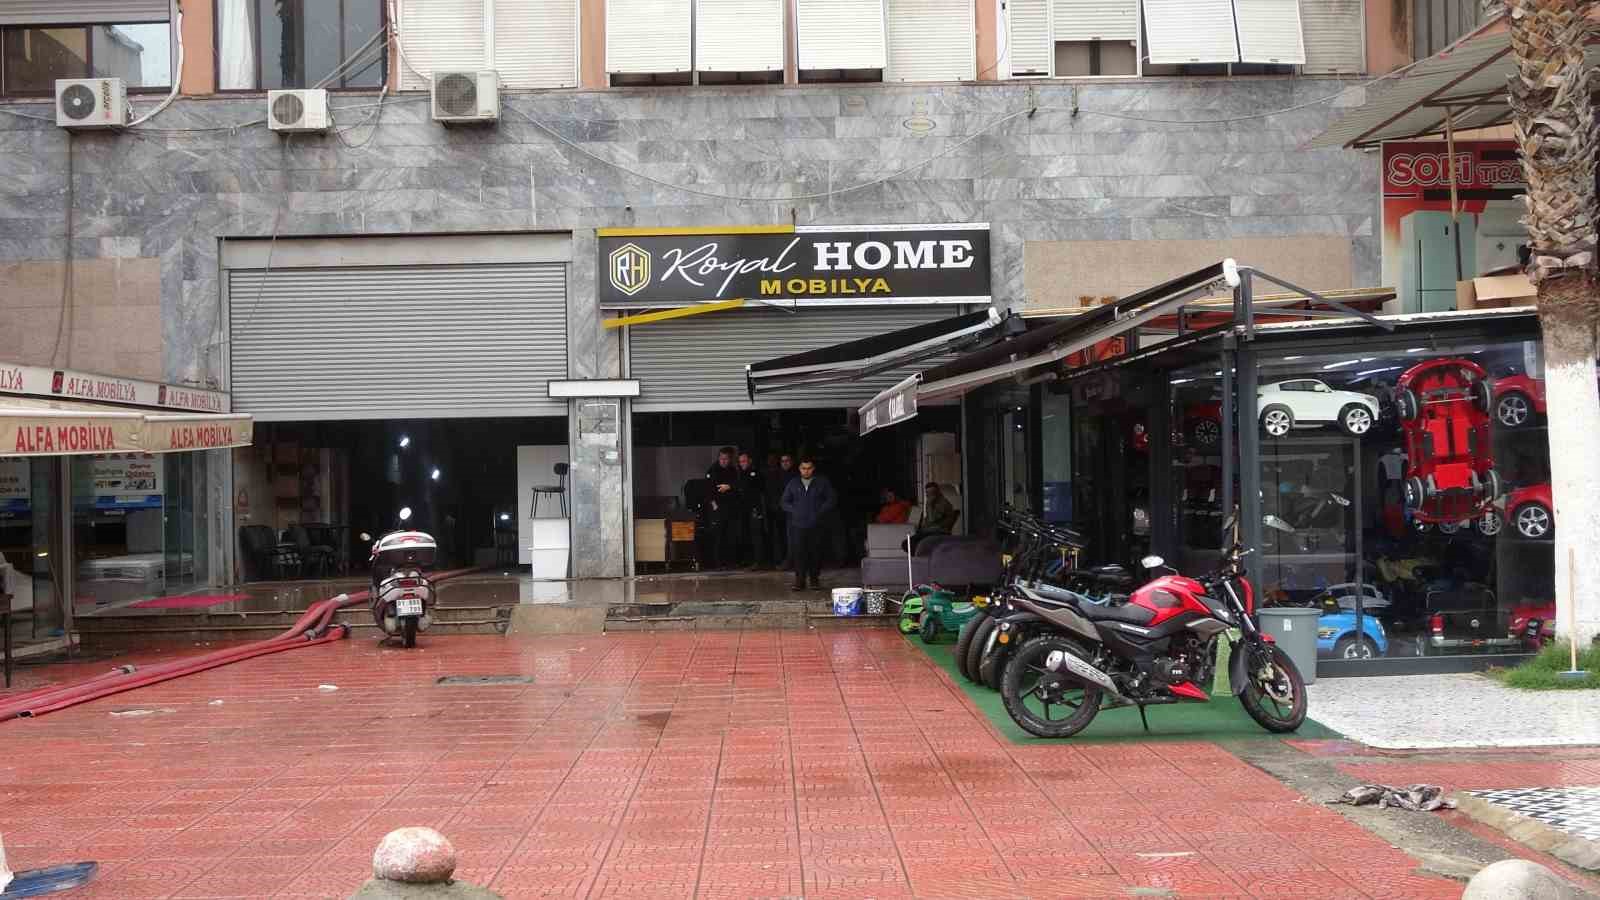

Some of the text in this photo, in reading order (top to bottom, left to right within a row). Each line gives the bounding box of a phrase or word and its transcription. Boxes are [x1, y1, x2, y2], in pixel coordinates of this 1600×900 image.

[661, 237, 975, 297] Royal HOME
[760, 277, 893, 295] MOBILYA
[66, 377, 94, 397] ALFA
[168, 391, 189, 408] ALFA
[16, 421, 115, 452] ALFA MOBİLYA
[170, 427, 195, 449] ALFA
